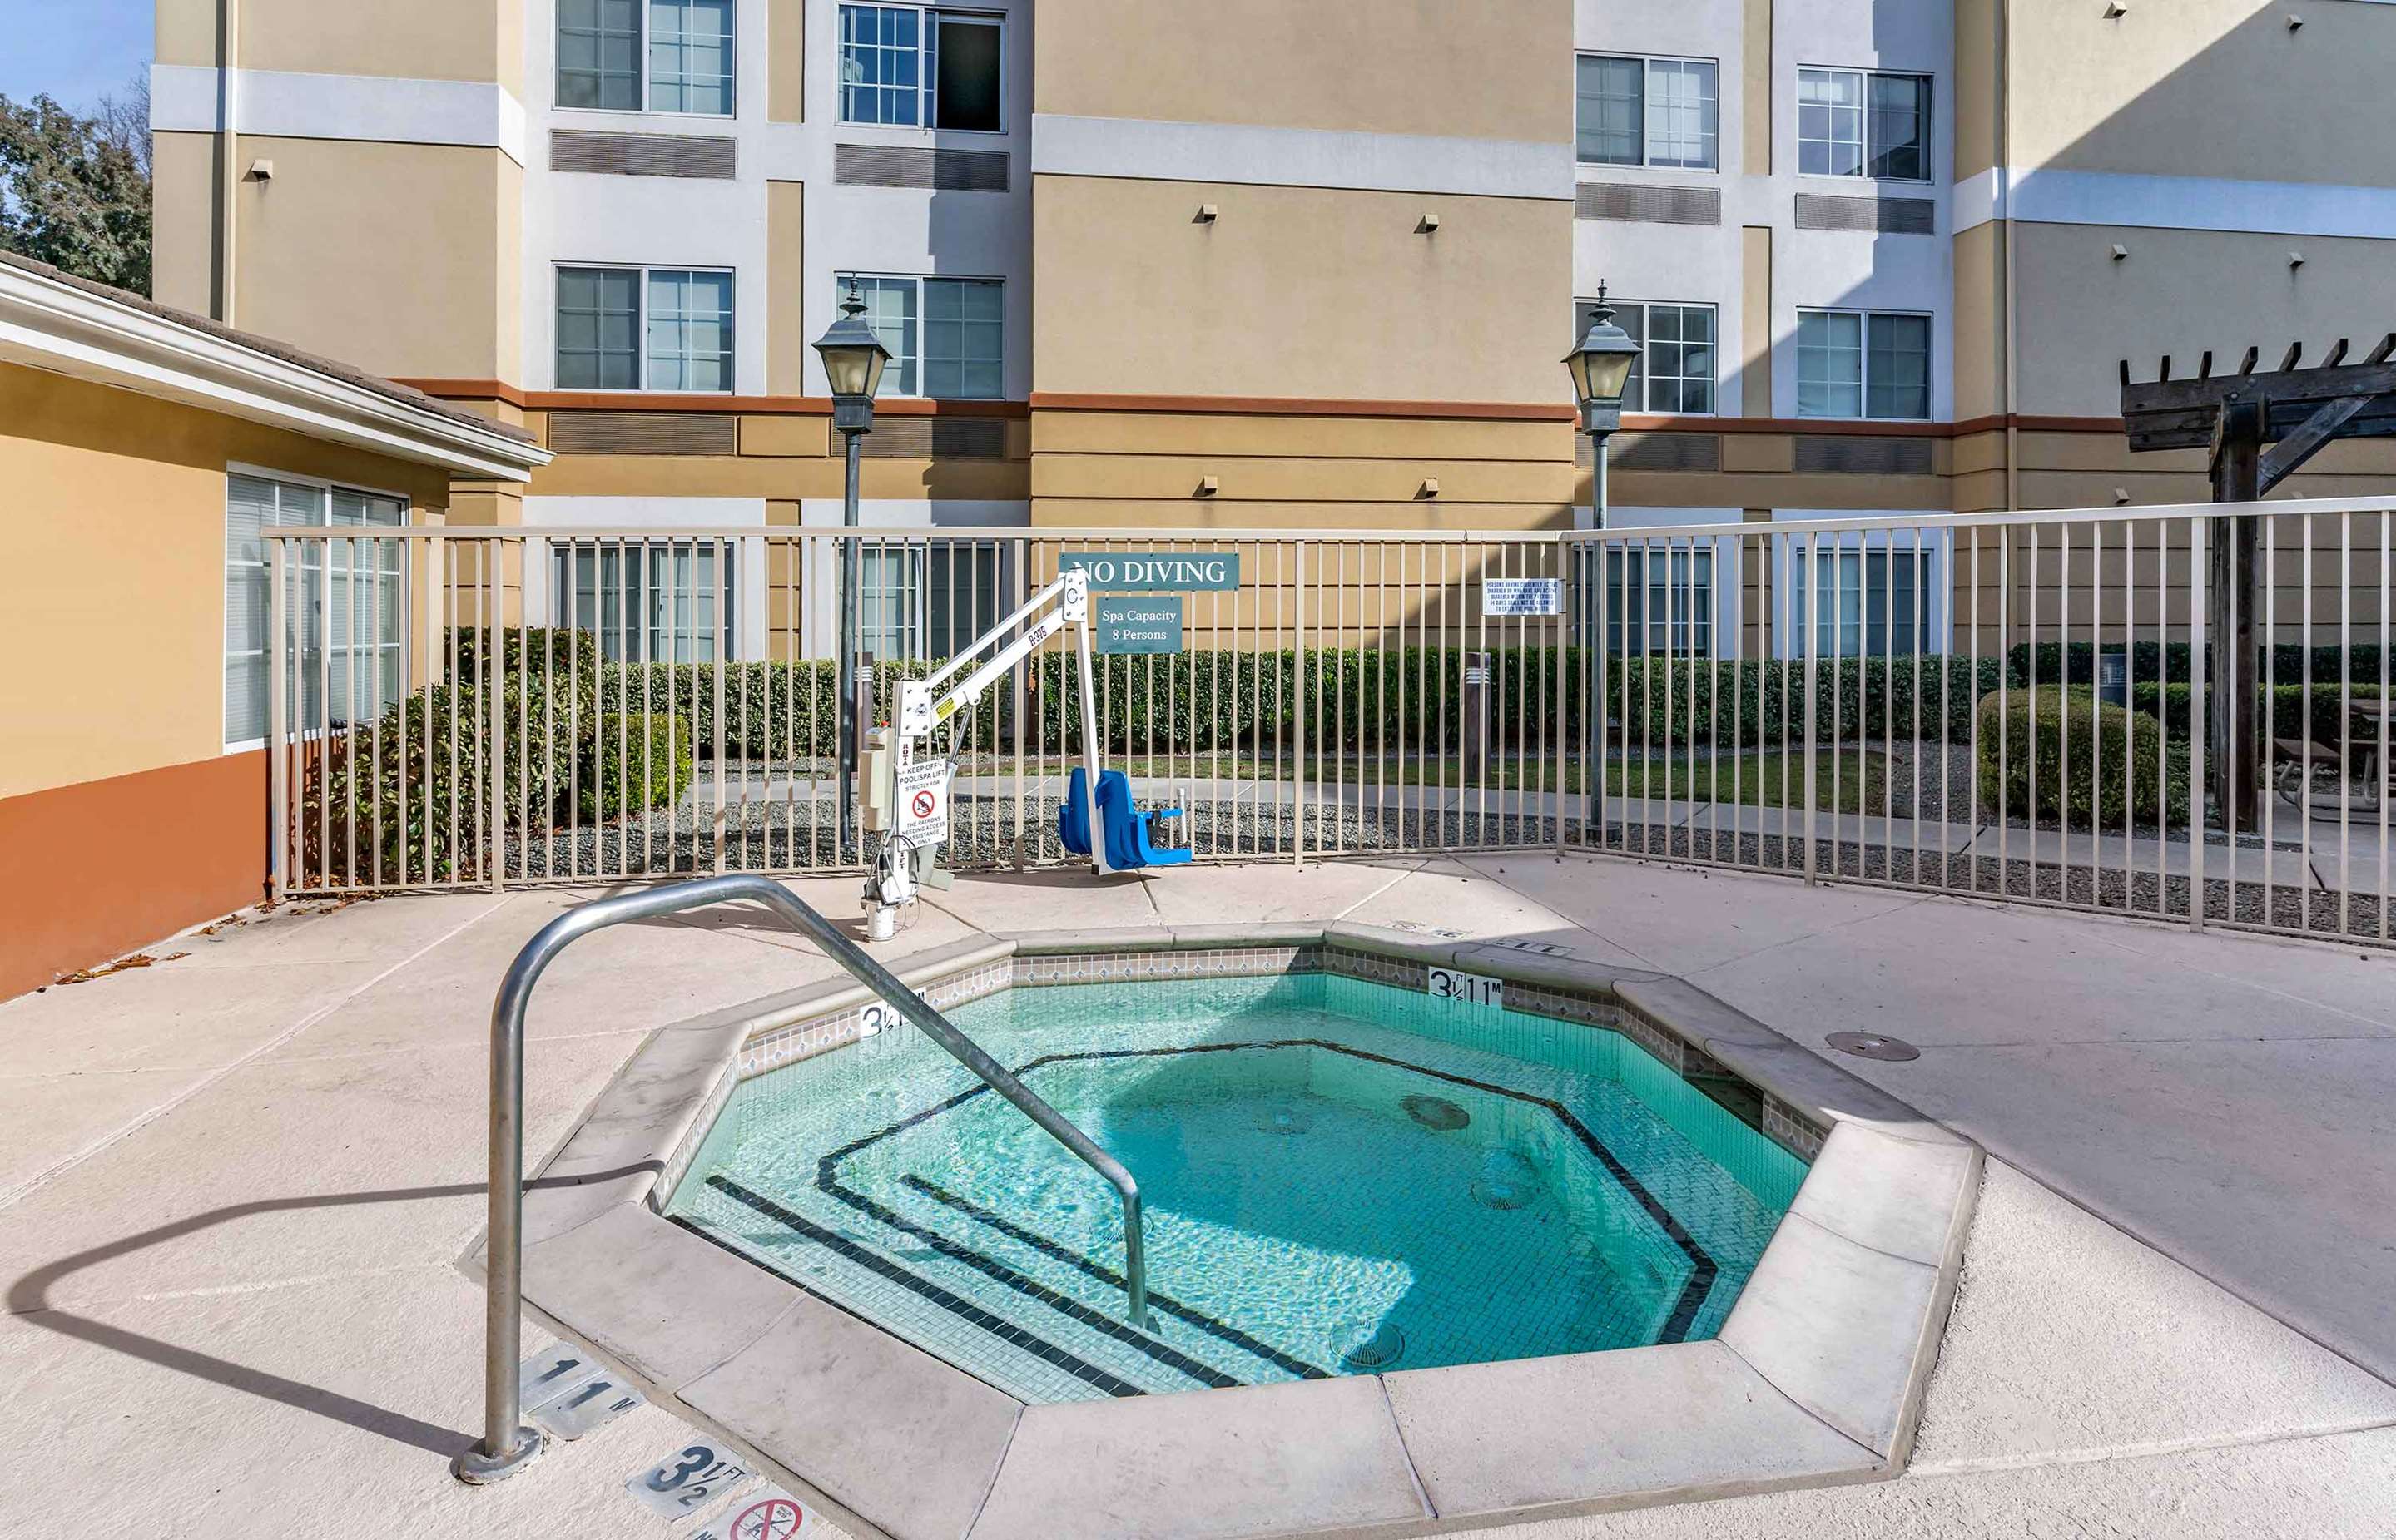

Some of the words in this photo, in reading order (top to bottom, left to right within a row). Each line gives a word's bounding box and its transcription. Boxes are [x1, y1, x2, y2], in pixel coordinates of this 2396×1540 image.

[1123, 561, 1228, 582] DIVING
[1102, 610, 1124, 622] Spa
[1126, 609, 1177, 623] Capacity
[1112, 630, 1119, 641] 8
[1123, 630, 1167, 641] Persons
[907, 765, 925, 774] KEEP
[932, 770, 945, 778] LIFT
[918, 816, 940, 825] PATRONS
[925, 821, 945, 830] ACCESS
[909, 829, 940, 840] ASSISTANCE
[1456, 973, 1463, 982] FT
[1491, 982, 1501, 993] M
[723, 1466, 746, 1482] FT
